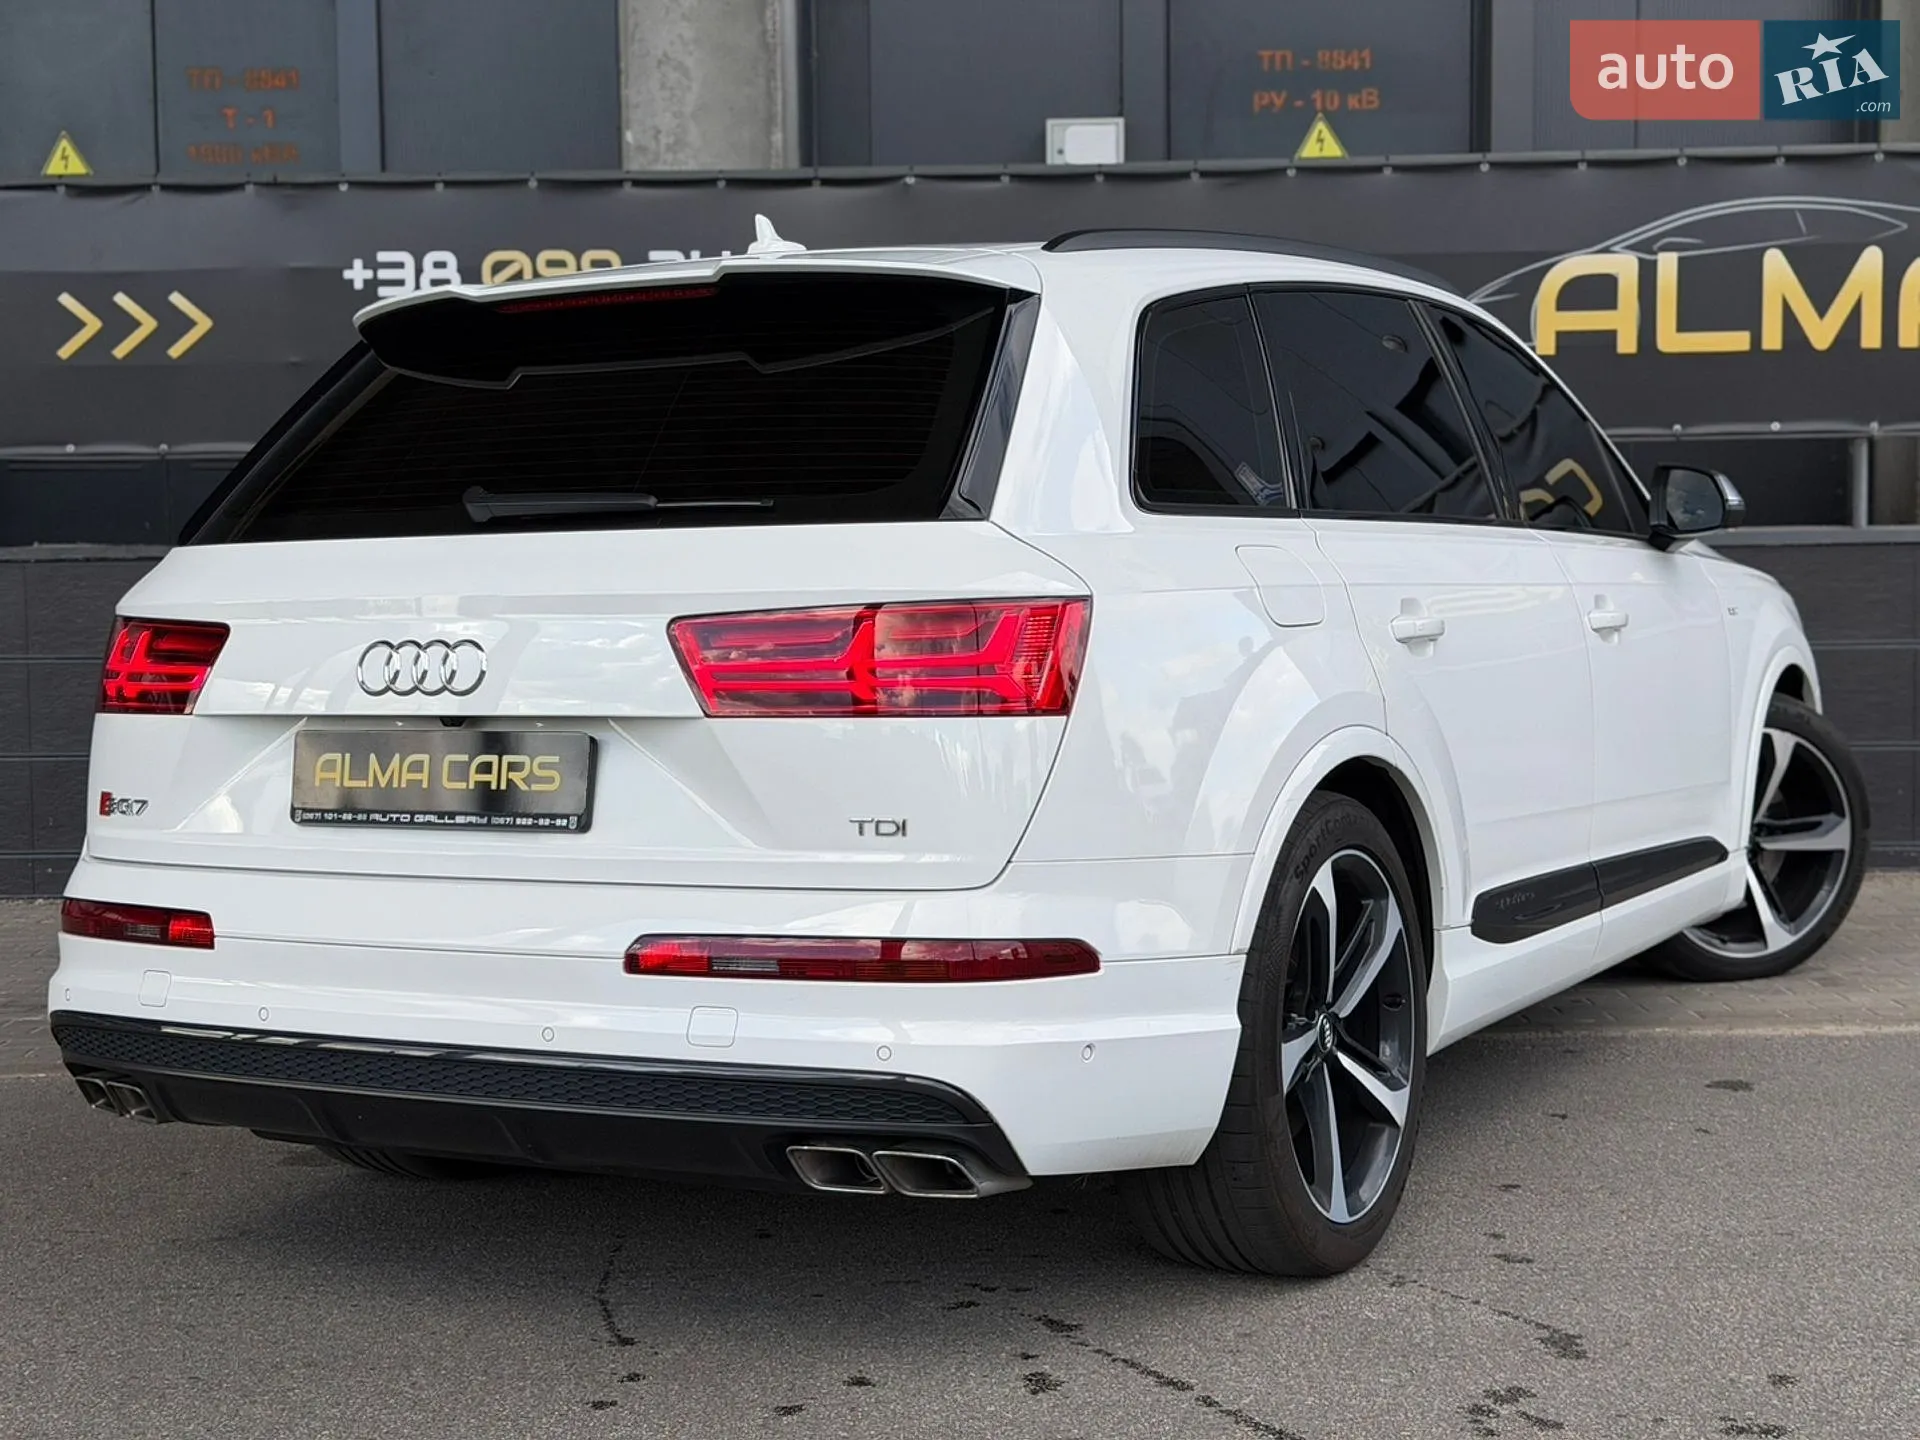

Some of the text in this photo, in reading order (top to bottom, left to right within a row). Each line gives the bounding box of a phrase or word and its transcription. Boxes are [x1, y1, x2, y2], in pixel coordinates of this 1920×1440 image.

[1311, 89, 1341, 112] 10
[342, 249, 462, 298] +38
[1535, 245, 1920, 356] ALM
[314, 752, 561, 791] ALMA CARS
[369, 813, 411, 822] AUTO
[414, 814, 488, 825] GALLERY
[849, 818, 907, 837] TDI
